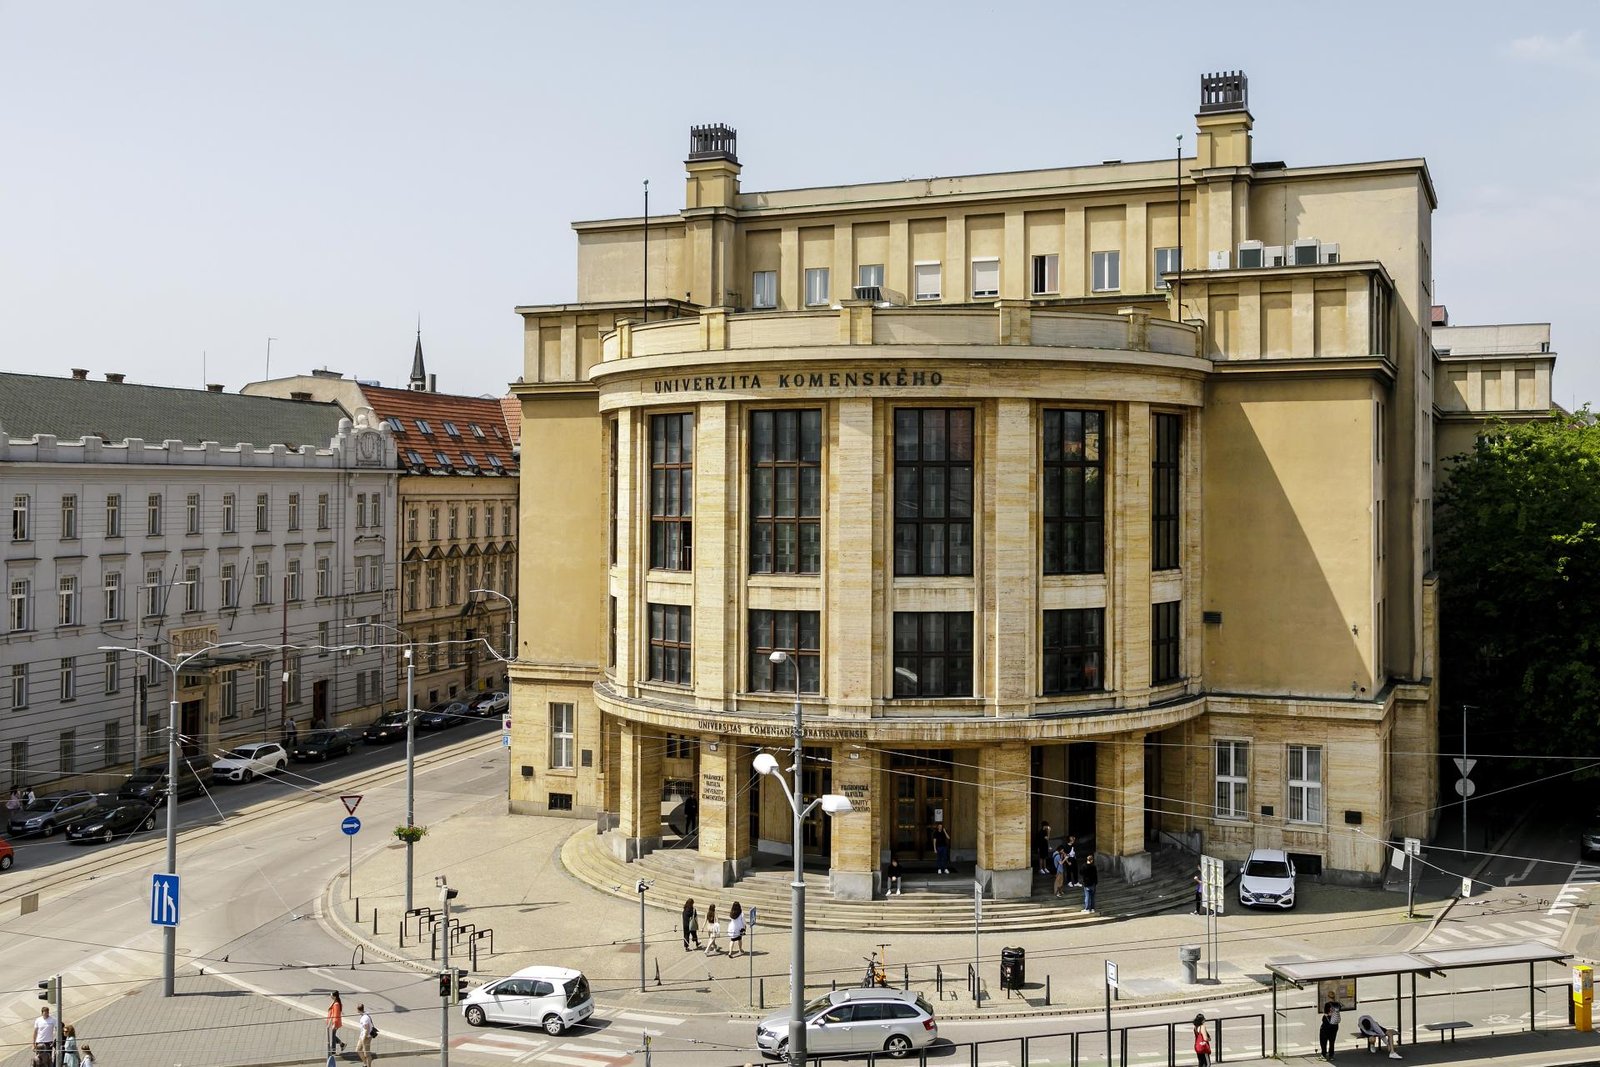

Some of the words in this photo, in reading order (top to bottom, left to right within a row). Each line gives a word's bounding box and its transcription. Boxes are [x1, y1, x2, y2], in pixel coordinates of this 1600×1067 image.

[655, 375, 761, 394] UNIVERZITA
[779, 368, 942, 388] KOMENSKÉHO
[698, 720, 742, 733] UNIVERSITAS
[804, 728, 868, 739] BRATISLAVENSIS
